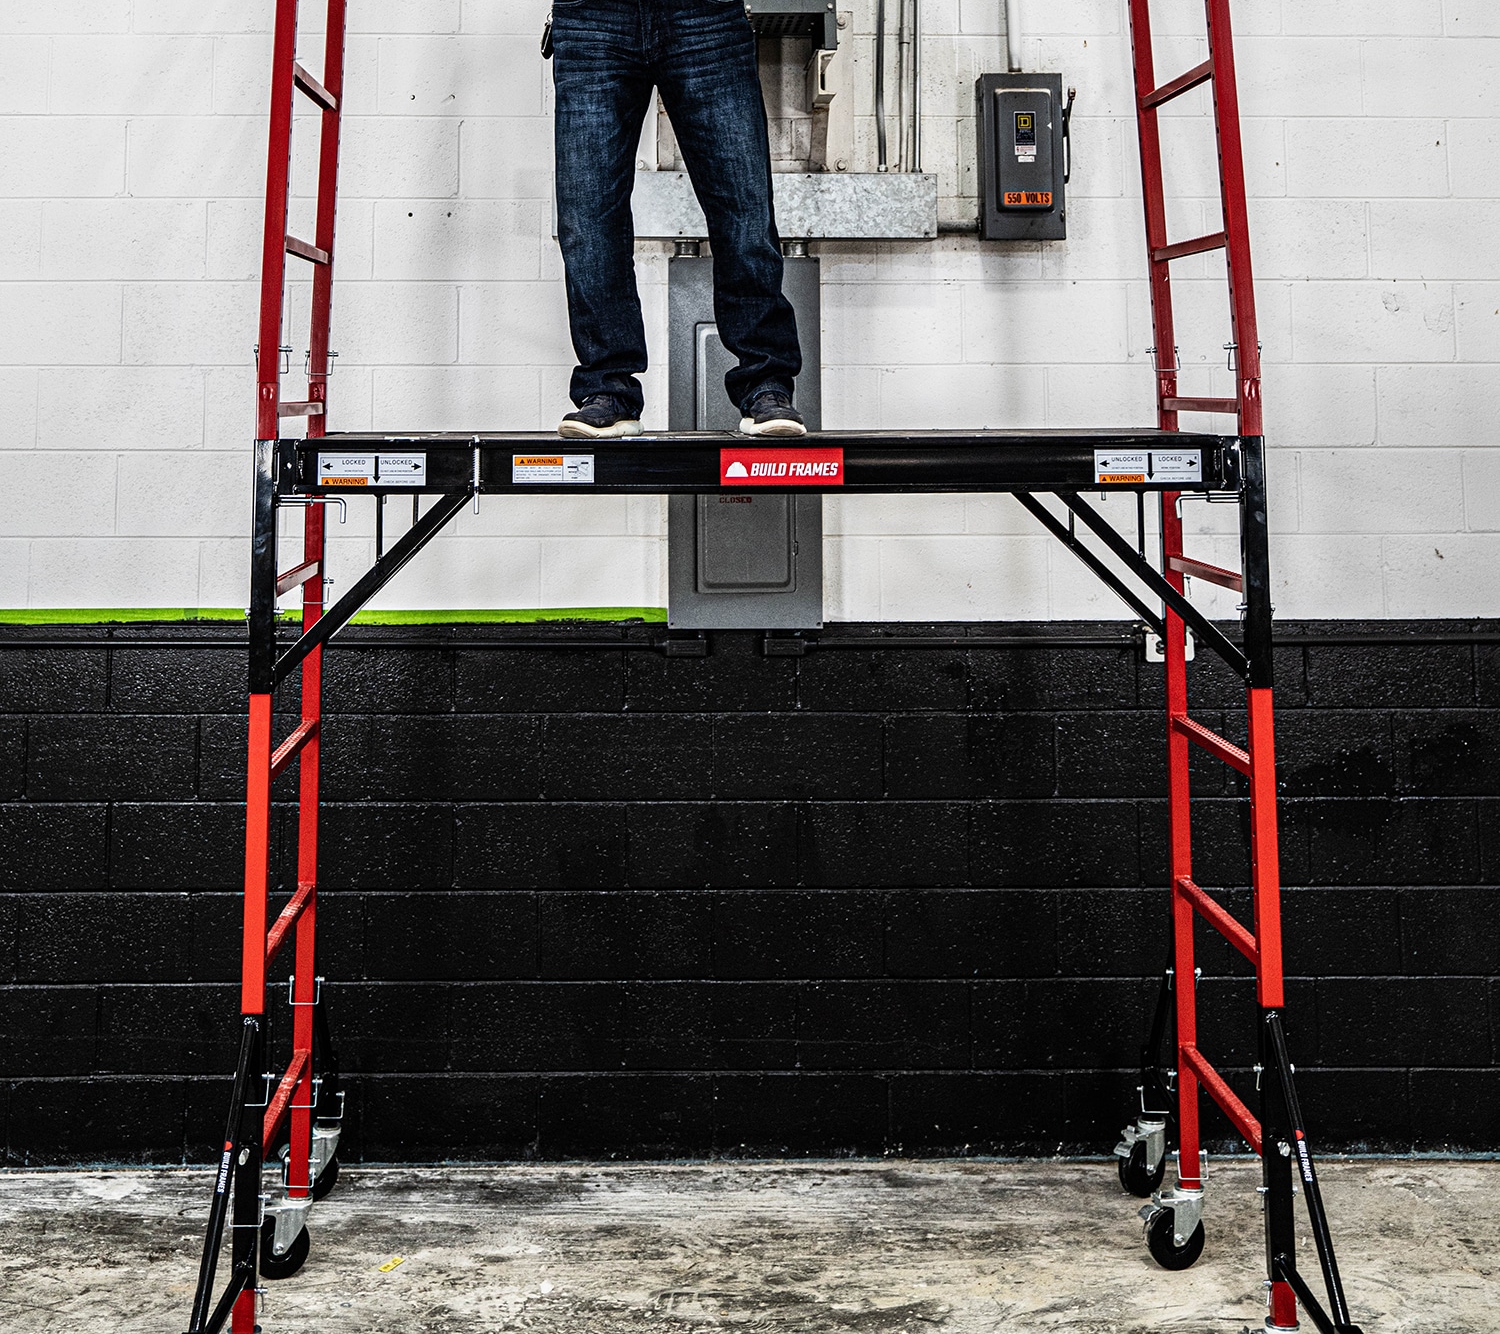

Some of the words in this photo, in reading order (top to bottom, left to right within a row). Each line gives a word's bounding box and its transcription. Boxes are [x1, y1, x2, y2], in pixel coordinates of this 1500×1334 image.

[1007, 192, 1021, 203] 550
[1025, 192, 1050, 203] VOLTS
[750, 462, 787, 476] BUILD
[788, 462, 839, 476] FRAMES
[1301, 1158, 1313, 1182] FRAMES
[217, 1169, 228, 1193] FRAMES
